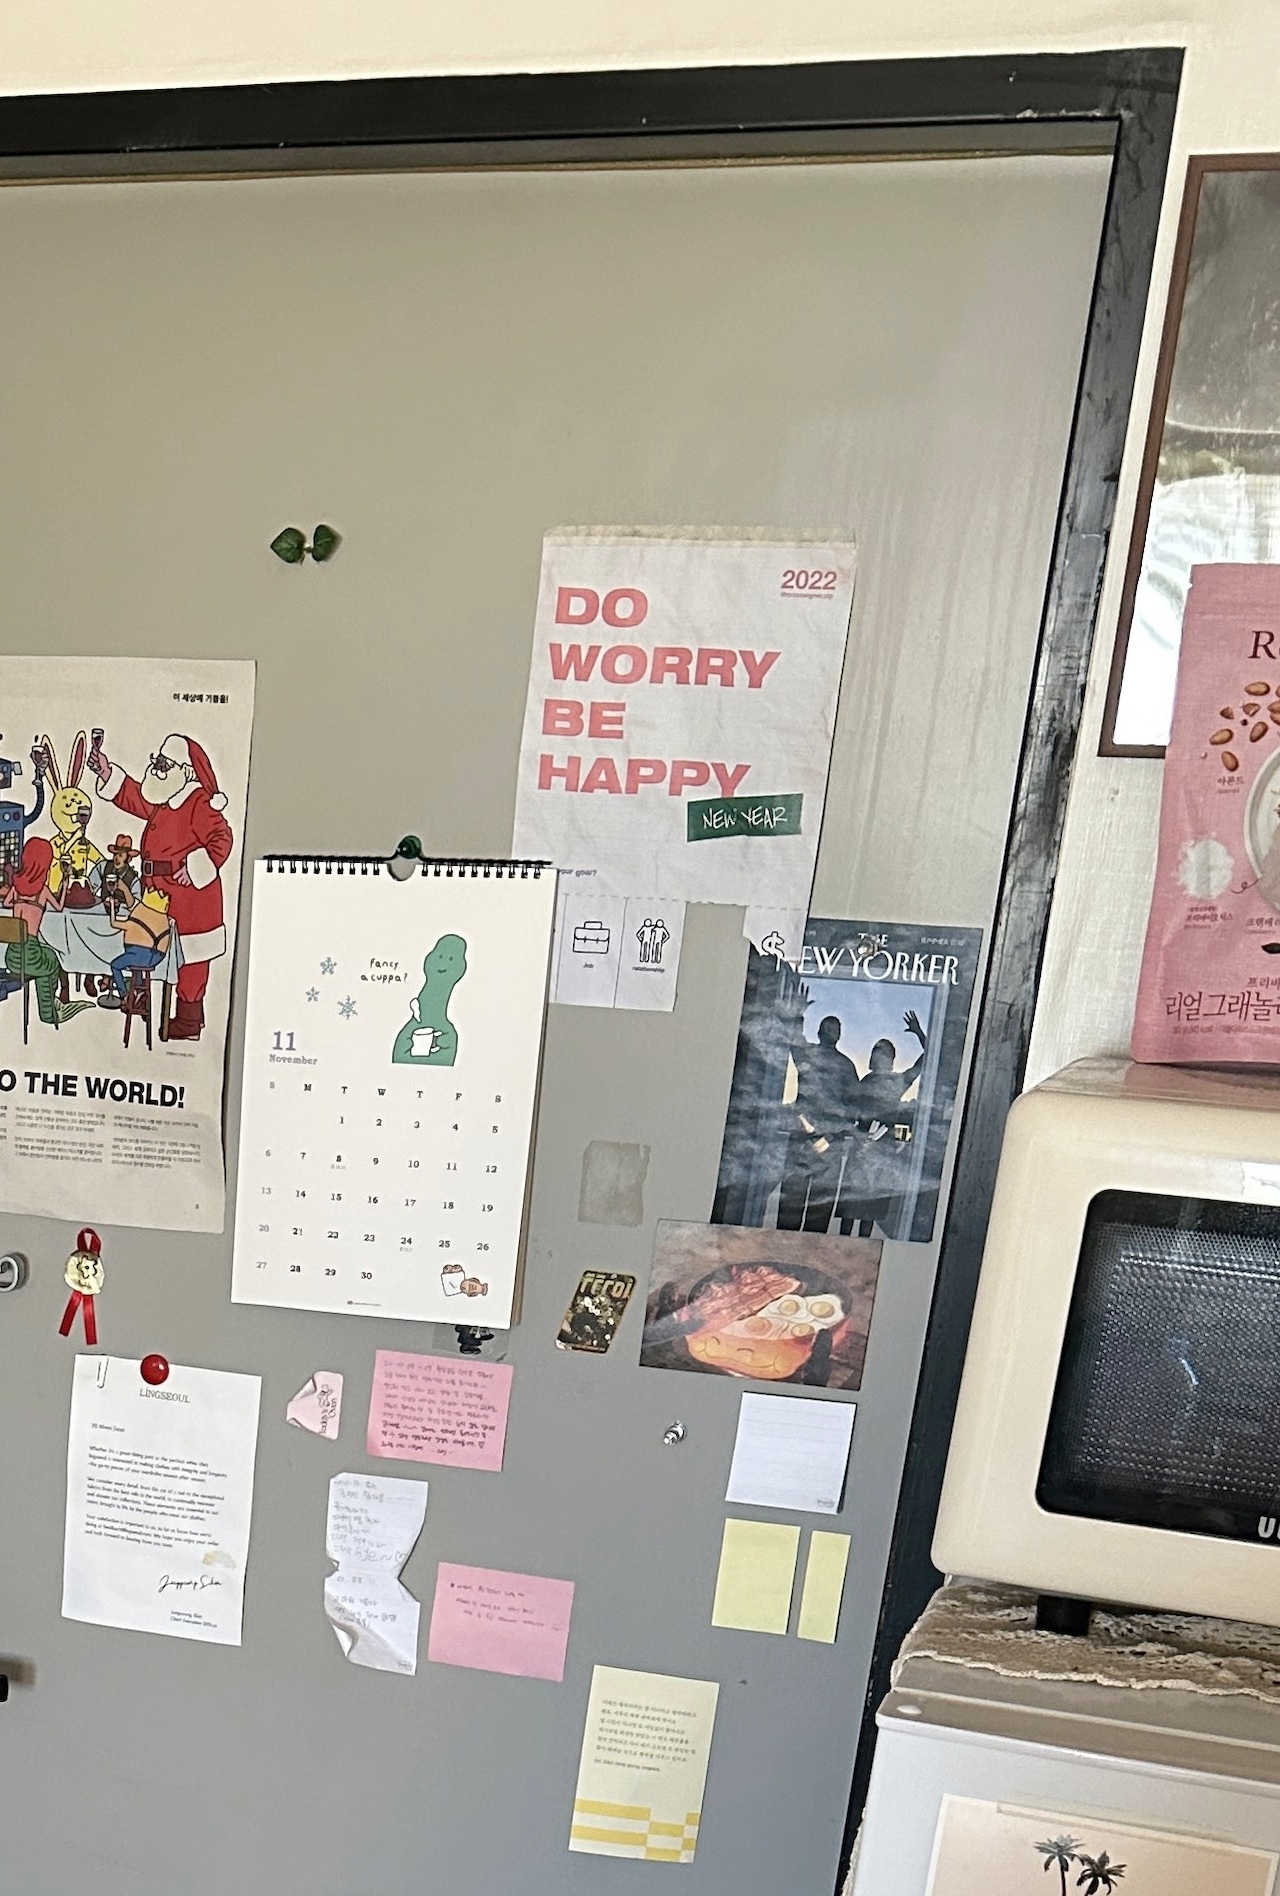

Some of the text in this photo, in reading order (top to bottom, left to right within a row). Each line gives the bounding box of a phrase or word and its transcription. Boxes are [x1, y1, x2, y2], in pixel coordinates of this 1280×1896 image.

[781, 570, 837, 590] 2022
[555, 586, 648, 627] DO
[1247, 630, 1280, 659] R
[548, 642, 782, 689] WORRY
[541, 698, 627, 739] BE
[537, 754, 751, 798] HAPPY
[702, 806, 788, 831] NEW YEAR
[360, 972, 408, 984] a cuppa?
[849, 948, 960, 986] YORKER
[271, 1031, 297, 1051] 11
[268, 1053, 319, 1066] November
[23, 1071, 78, 1098] THE
[85, 1076, 186, 1110] WORLD!
[269, 1081, 502, 1103] S M T W T F S
[339, 1116, 499, 1134] 1 2 3 4 5
[265, 1149, 272, 1157] 6
[335, 1154, 342, 1163] 8
[372, 1157, 379, 1166] 9
[408, 1159, 420, 1169] 10
[446, 1162, 457, 1171] 11
[485, 1165, 498, 1174] 12
[261, 1186, 494, 1213] 13 14 15 16 17 18 19
[258, 1224, 490, 1251] 20 21 22 23 24 25 26
[256, 1261, 373, 1280] 27 28 29 30
[1257, 1515, 1280, 1540] U
